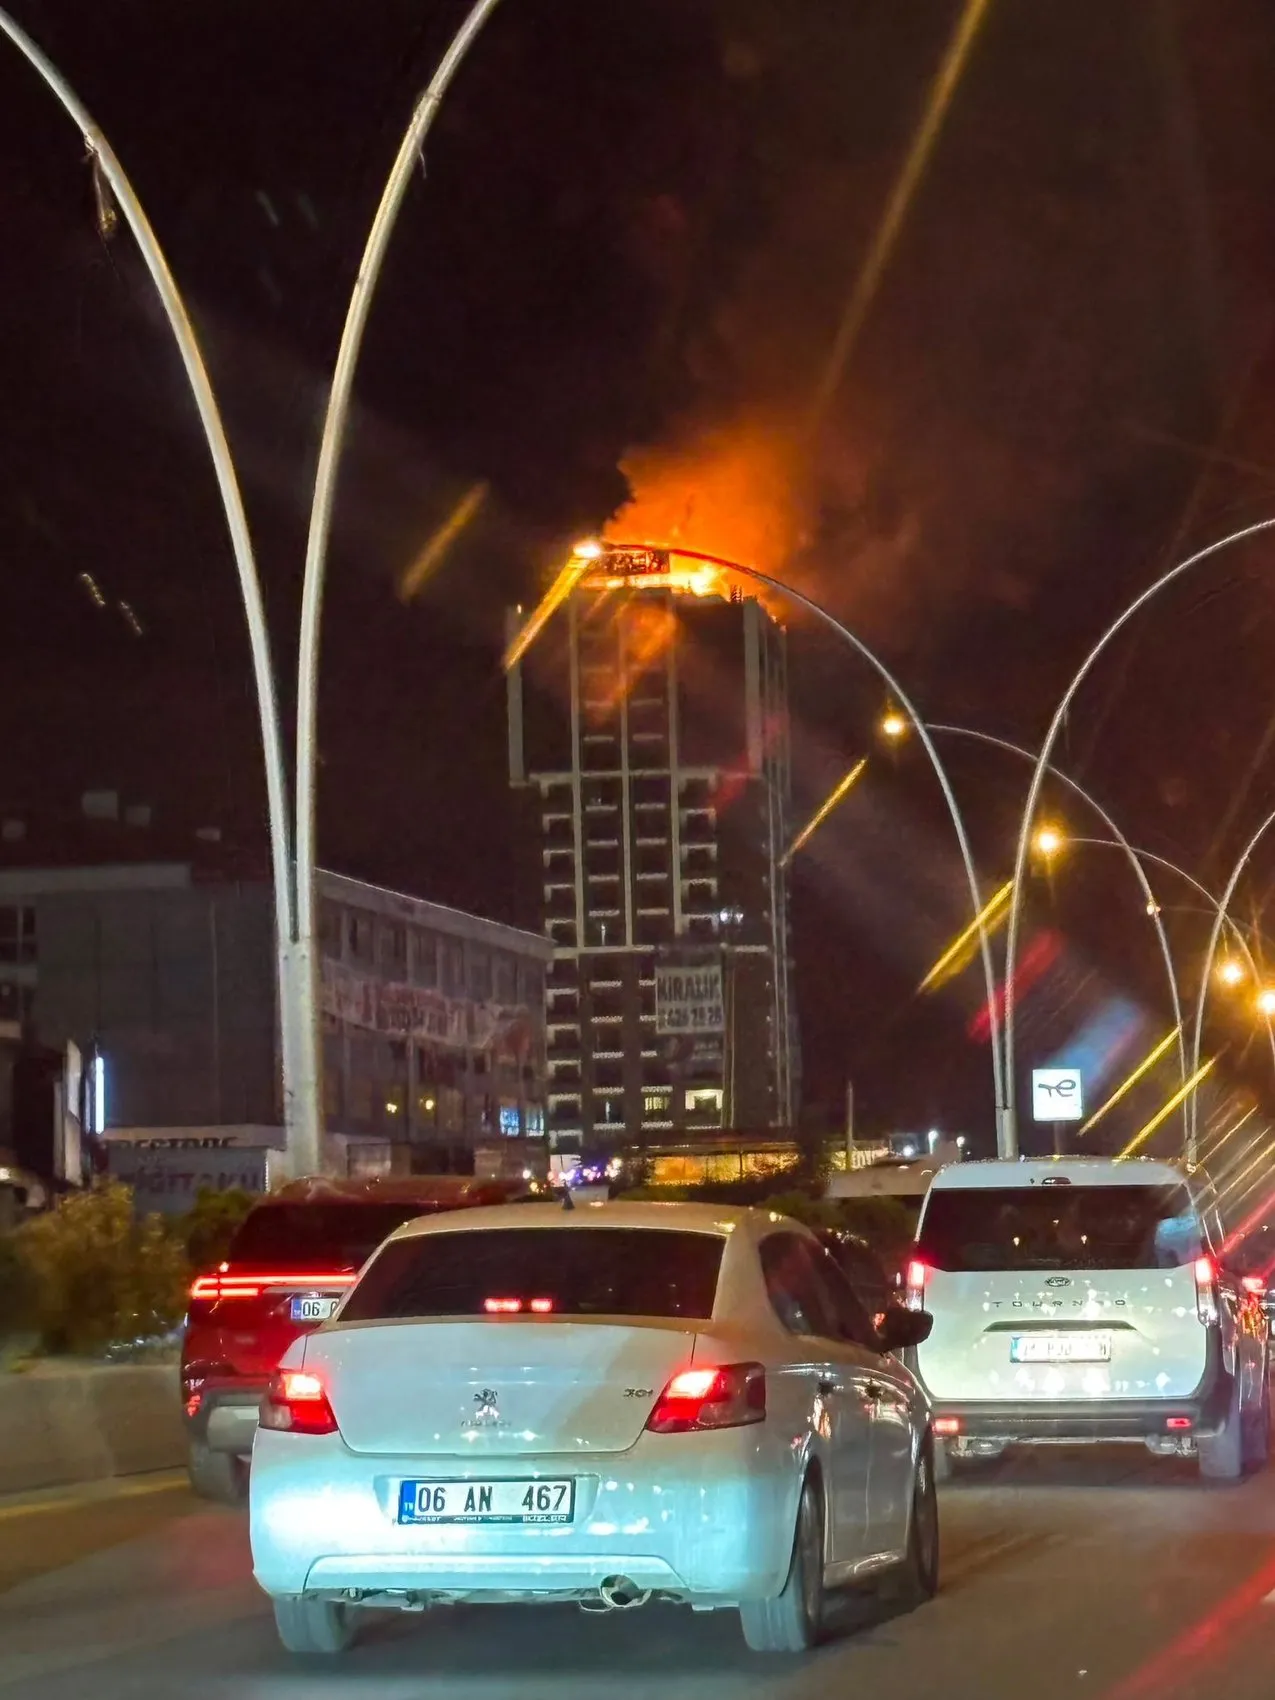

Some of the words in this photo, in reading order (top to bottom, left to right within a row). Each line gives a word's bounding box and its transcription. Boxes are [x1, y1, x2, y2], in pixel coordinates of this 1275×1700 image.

[302, 1302, 321, 1316] 06
[992, 1299, 1126, 1308] TOURNO
[418, 1486, 447, 1512] 06
[464, 1485, 493, 1512] AN
[521, 1484, 567, 1511] 467
